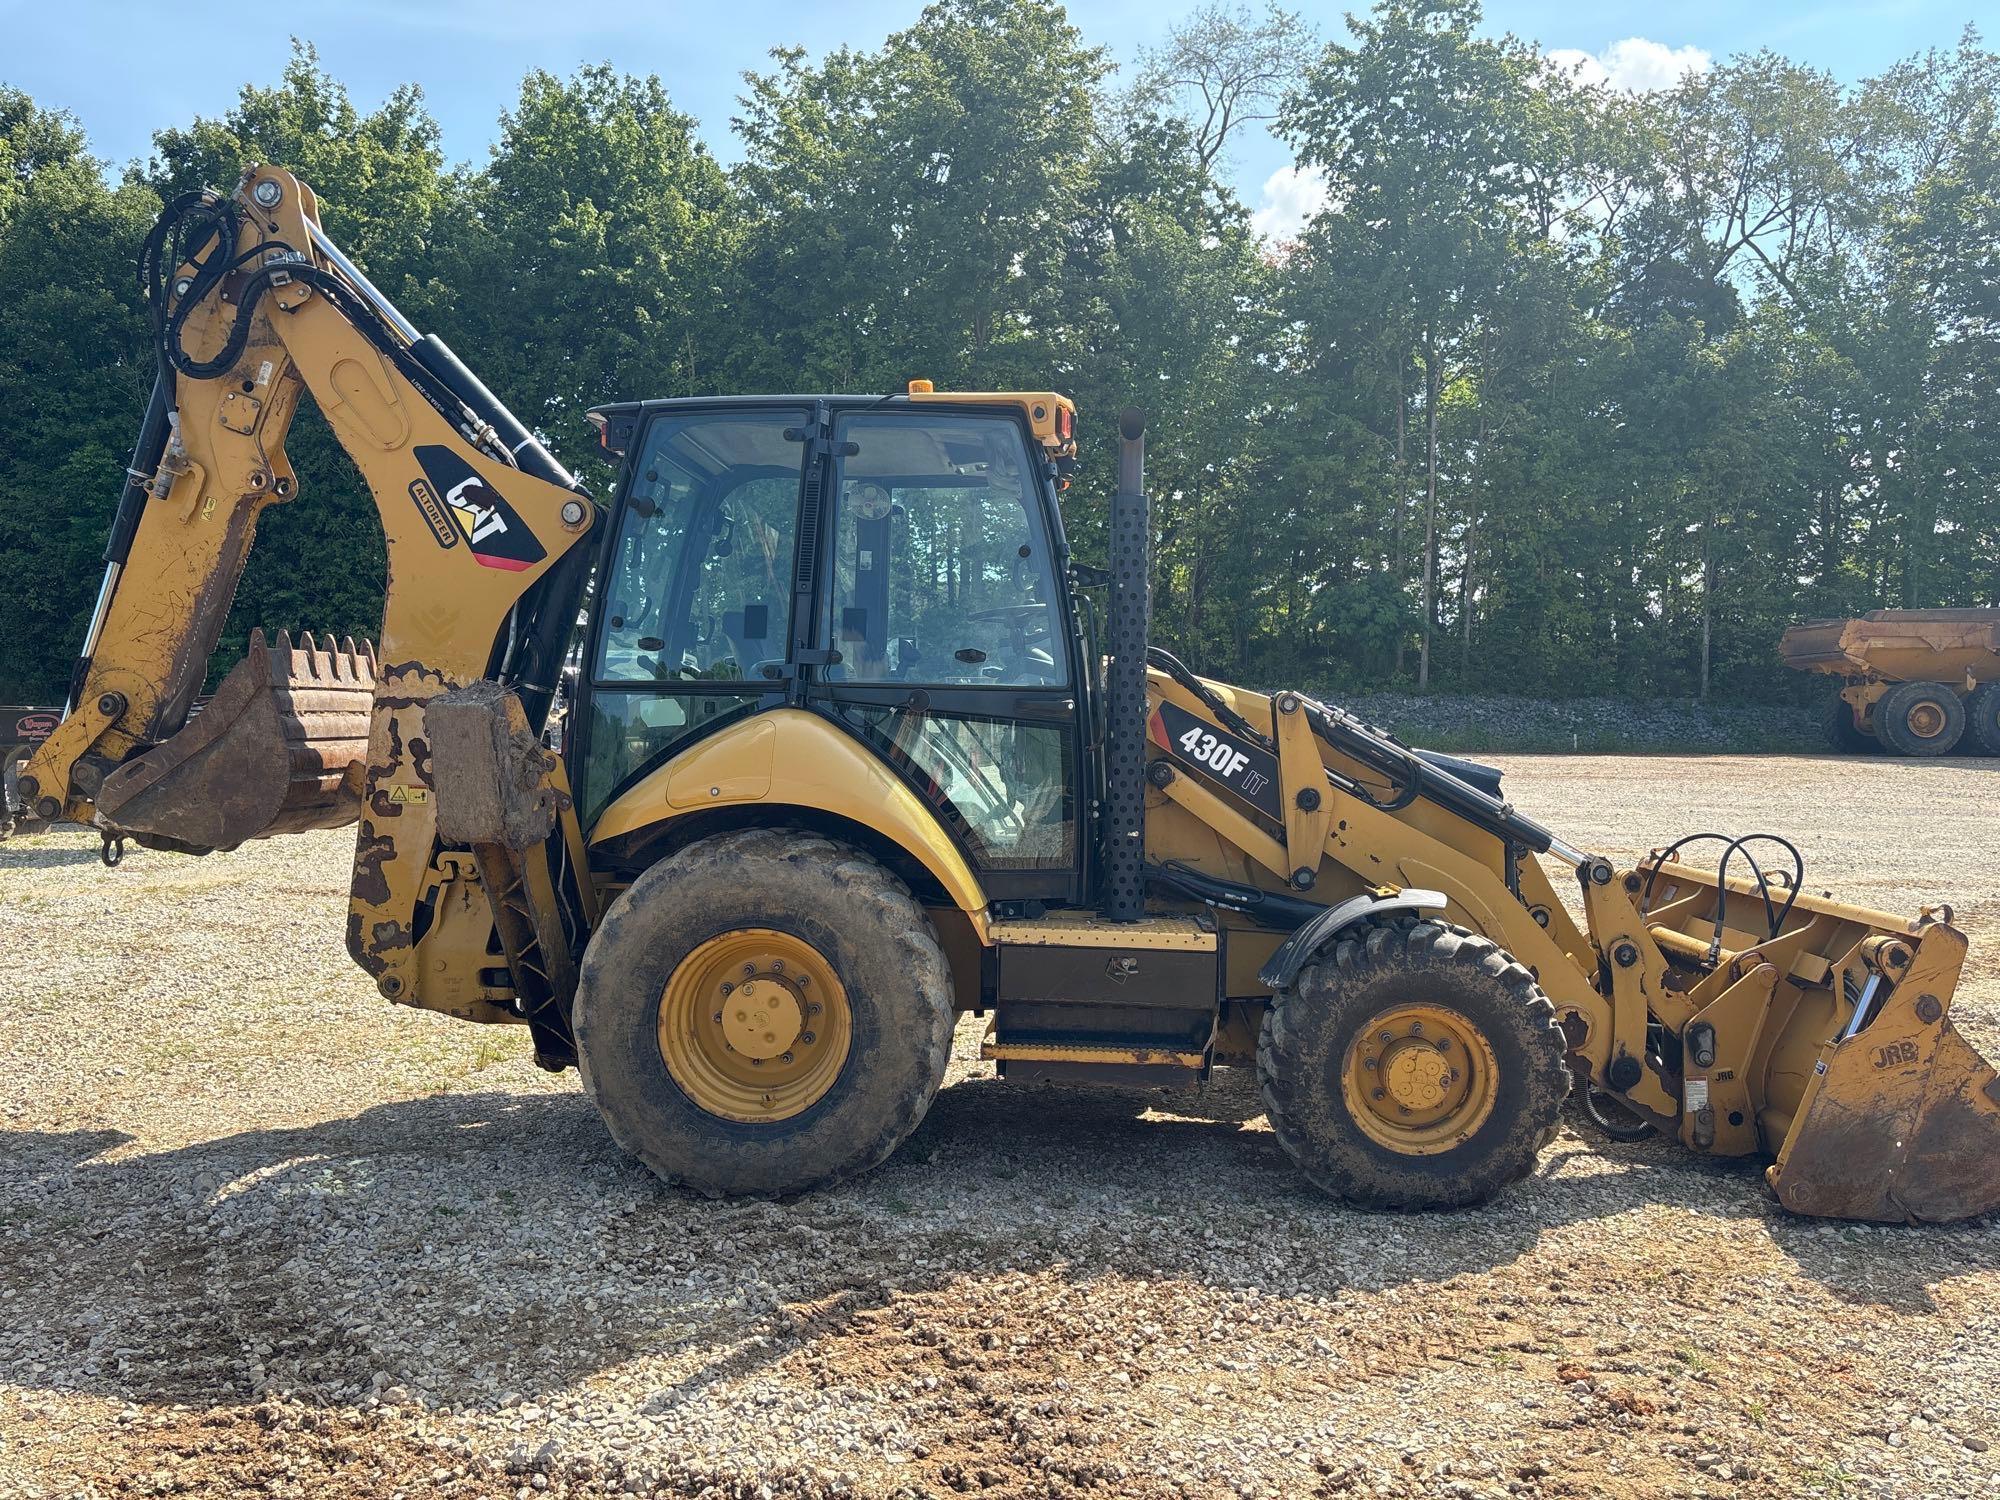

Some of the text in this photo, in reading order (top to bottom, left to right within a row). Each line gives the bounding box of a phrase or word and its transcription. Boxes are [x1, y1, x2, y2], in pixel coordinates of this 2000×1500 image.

[415, 487, 452, 541] ALTORFER
[1179, 726, 1269, 796] 430F IT
[1874, 1041, 1918, 1069] JRB
[1715, 1070, 1734, 1082] JRB
